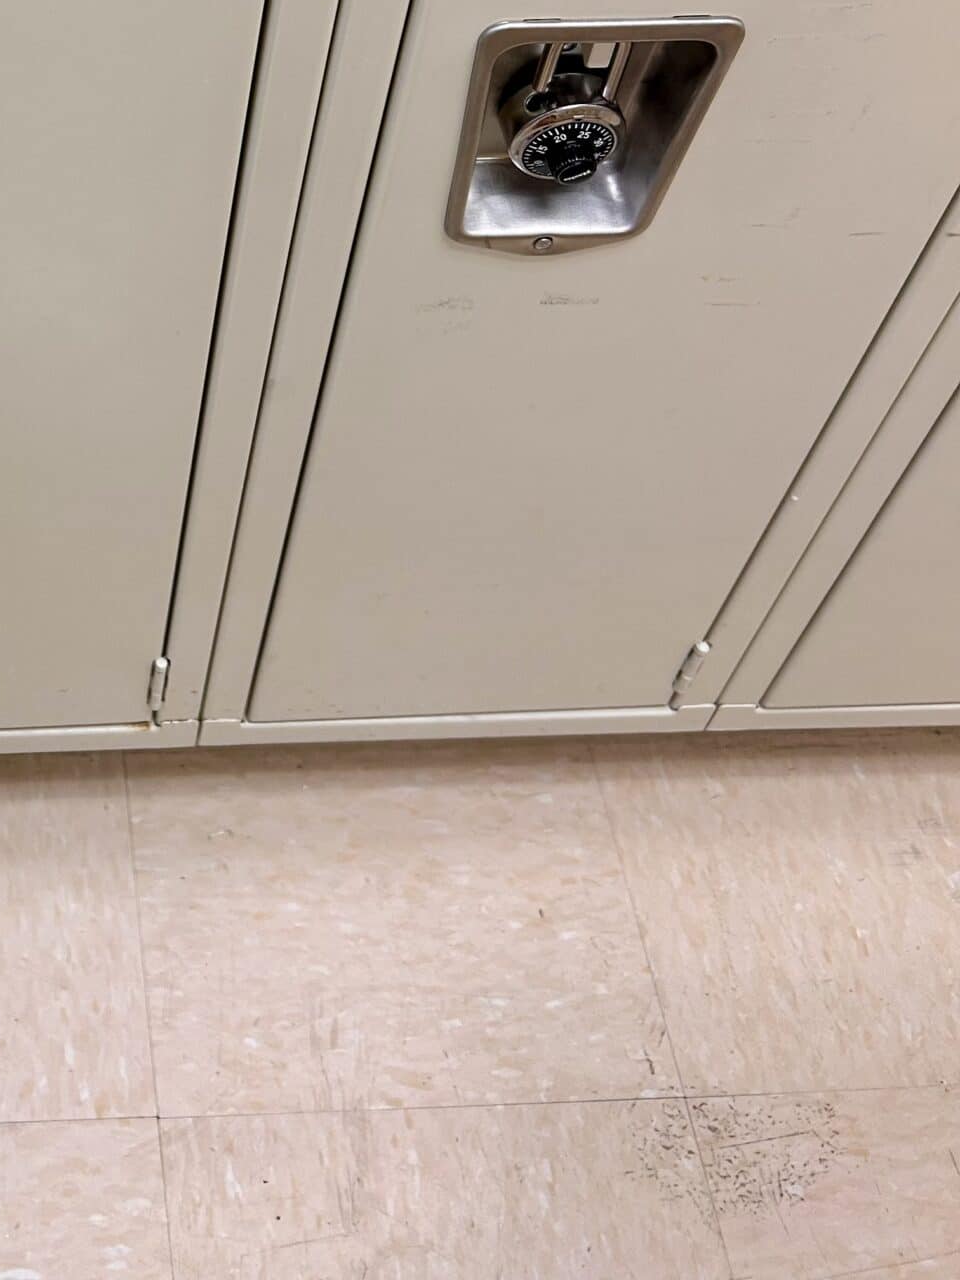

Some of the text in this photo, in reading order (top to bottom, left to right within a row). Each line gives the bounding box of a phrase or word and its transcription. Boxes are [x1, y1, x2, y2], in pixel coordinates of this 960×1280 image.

[553, 133, 567, 144] 20
[577, 131, 592, 139] 25
[535, 145, 548, 154] 15
